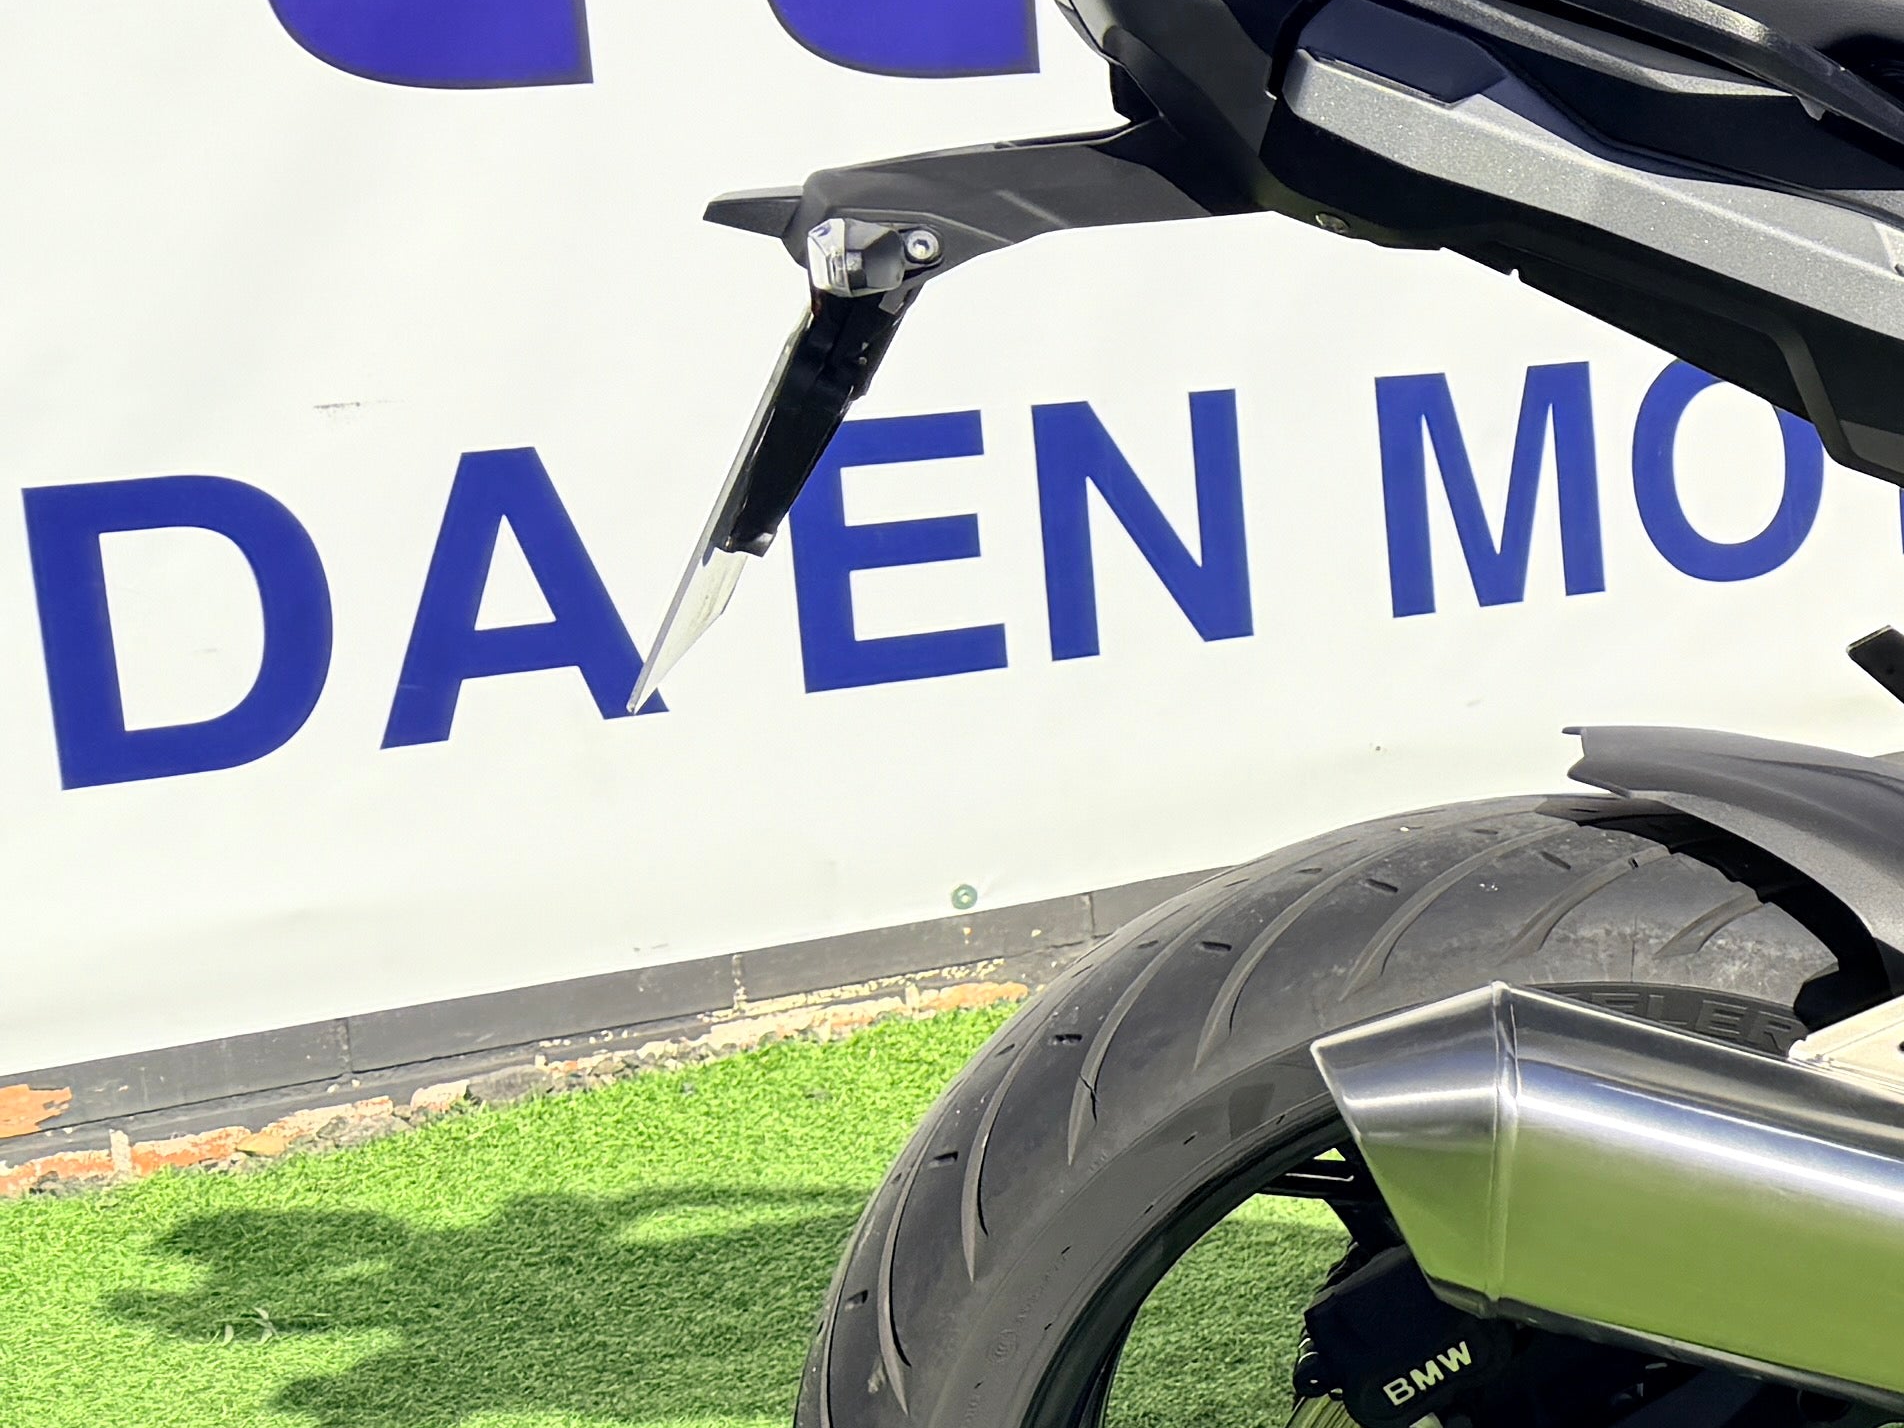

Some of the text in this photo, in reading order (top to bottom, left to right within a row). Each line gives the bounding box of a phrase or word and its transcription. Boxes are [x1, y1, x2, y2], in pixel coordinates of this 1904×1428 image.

[19, 442, 670, 792] DA
[788, 387, 1256, 695] EN
[1382, 1340, 1473, 1407] BMW
